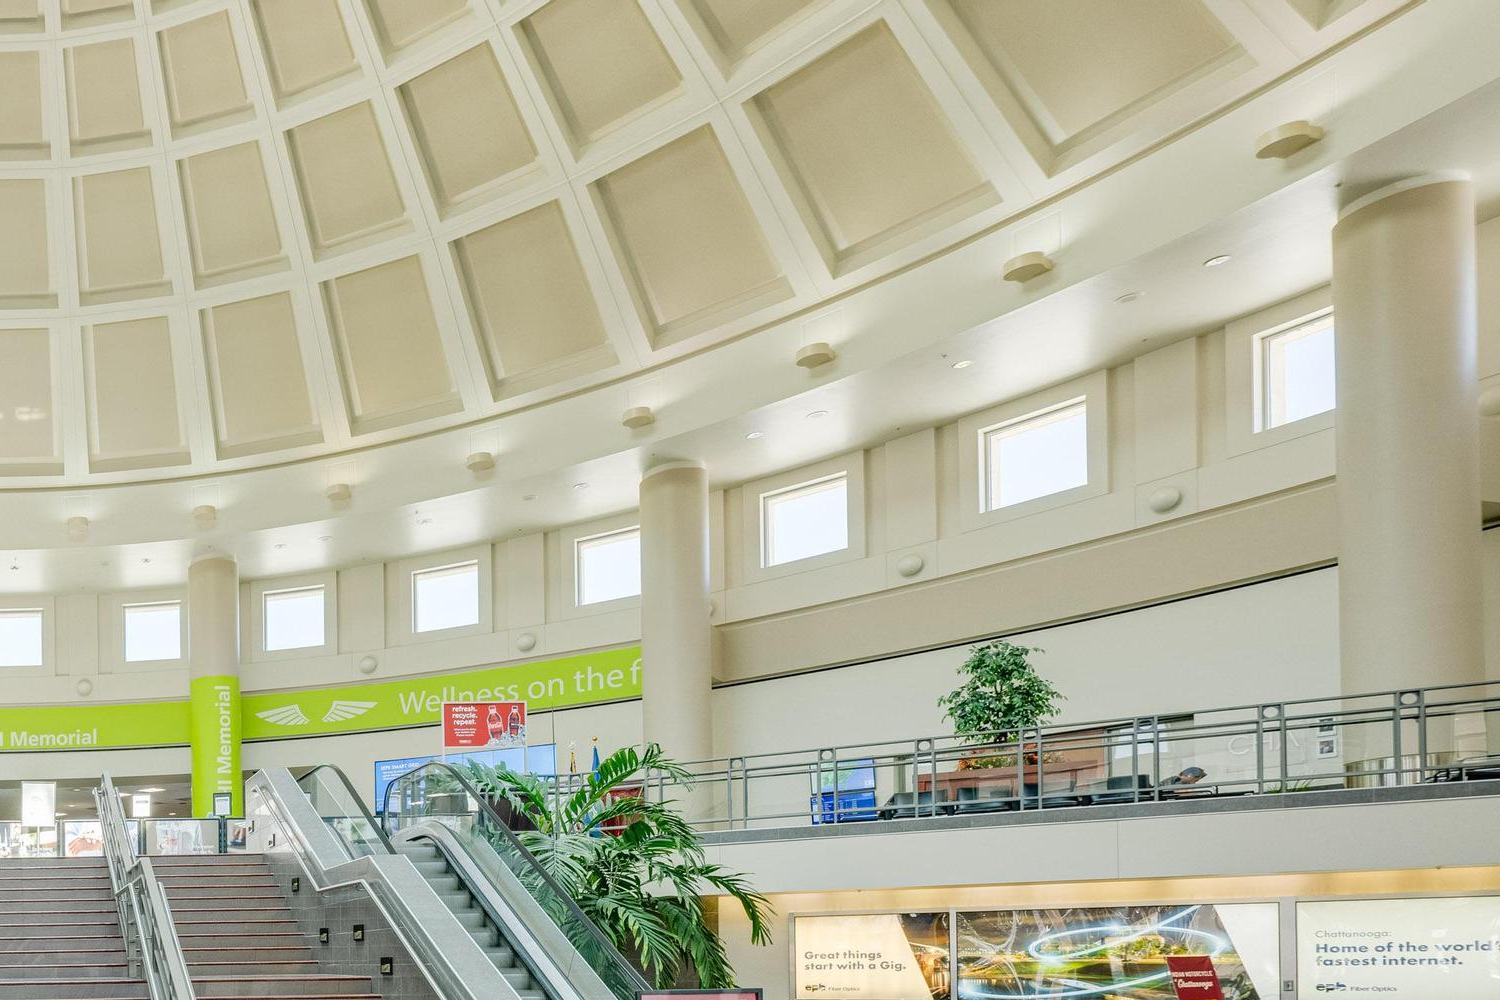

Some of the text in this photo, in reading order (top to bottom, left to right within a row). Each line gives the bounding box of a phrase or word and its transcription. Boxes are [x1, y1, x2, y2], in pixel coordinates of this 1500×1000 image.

[528, 678, 564, 700] on
[574, 668, 624, 693] the
[214, 686, 233, 774] Memorial
[10, 729, 98, 747] Memorial
[1315, 930, 1392, 939] Chattanooga:
[1316, 940, 1500, 953] Home of the world'
[804, 950, 882, 961] Great things
[1316, 955, 1463, 966] fastest internet.
[804, 962, 833, 970] start
[837, 961, 864, 970] with
[880, 961, 906, 972] Gig.
